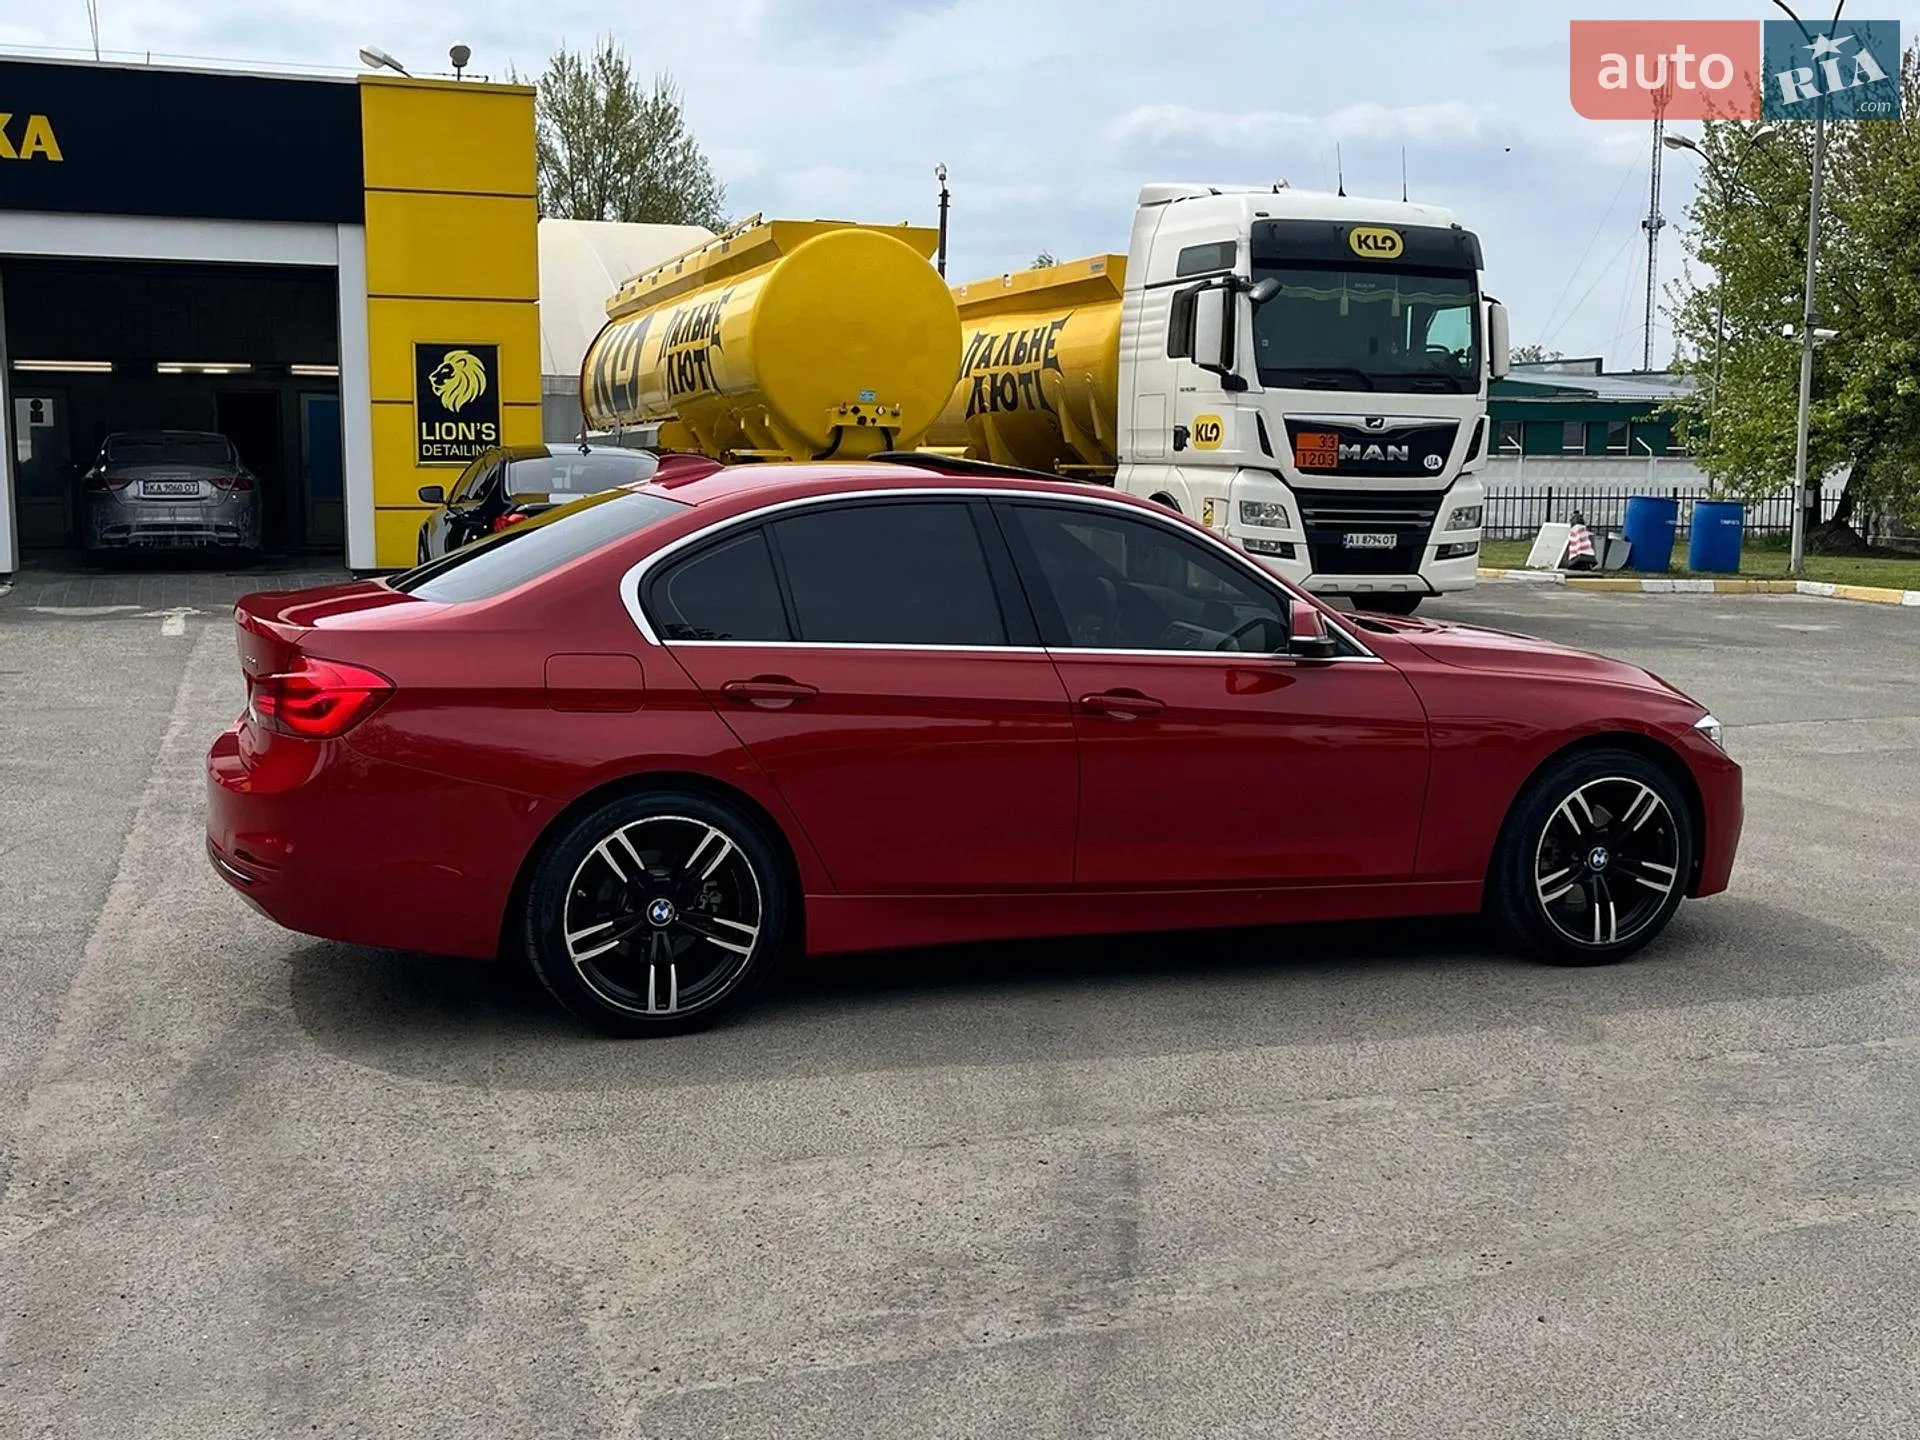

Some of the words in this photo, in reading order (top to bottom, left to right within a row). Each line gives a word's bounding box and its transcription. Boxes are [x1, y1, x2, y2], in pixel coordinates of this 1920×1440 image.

[1357, 234, 1396, 251] KLO
[656, 288, 736, 369] ПАЛЬНЕ
[958, 310, 1076, 382] ПАЛЬНЕ
[422, 422, 496, 441] LION'S
[1319, 435, 1336, 449] 33
[1301, 453, 1336, 466] 1203
[1338, 443, 1409, 461] MAN
[1426, 457, 1439, 468] UA
